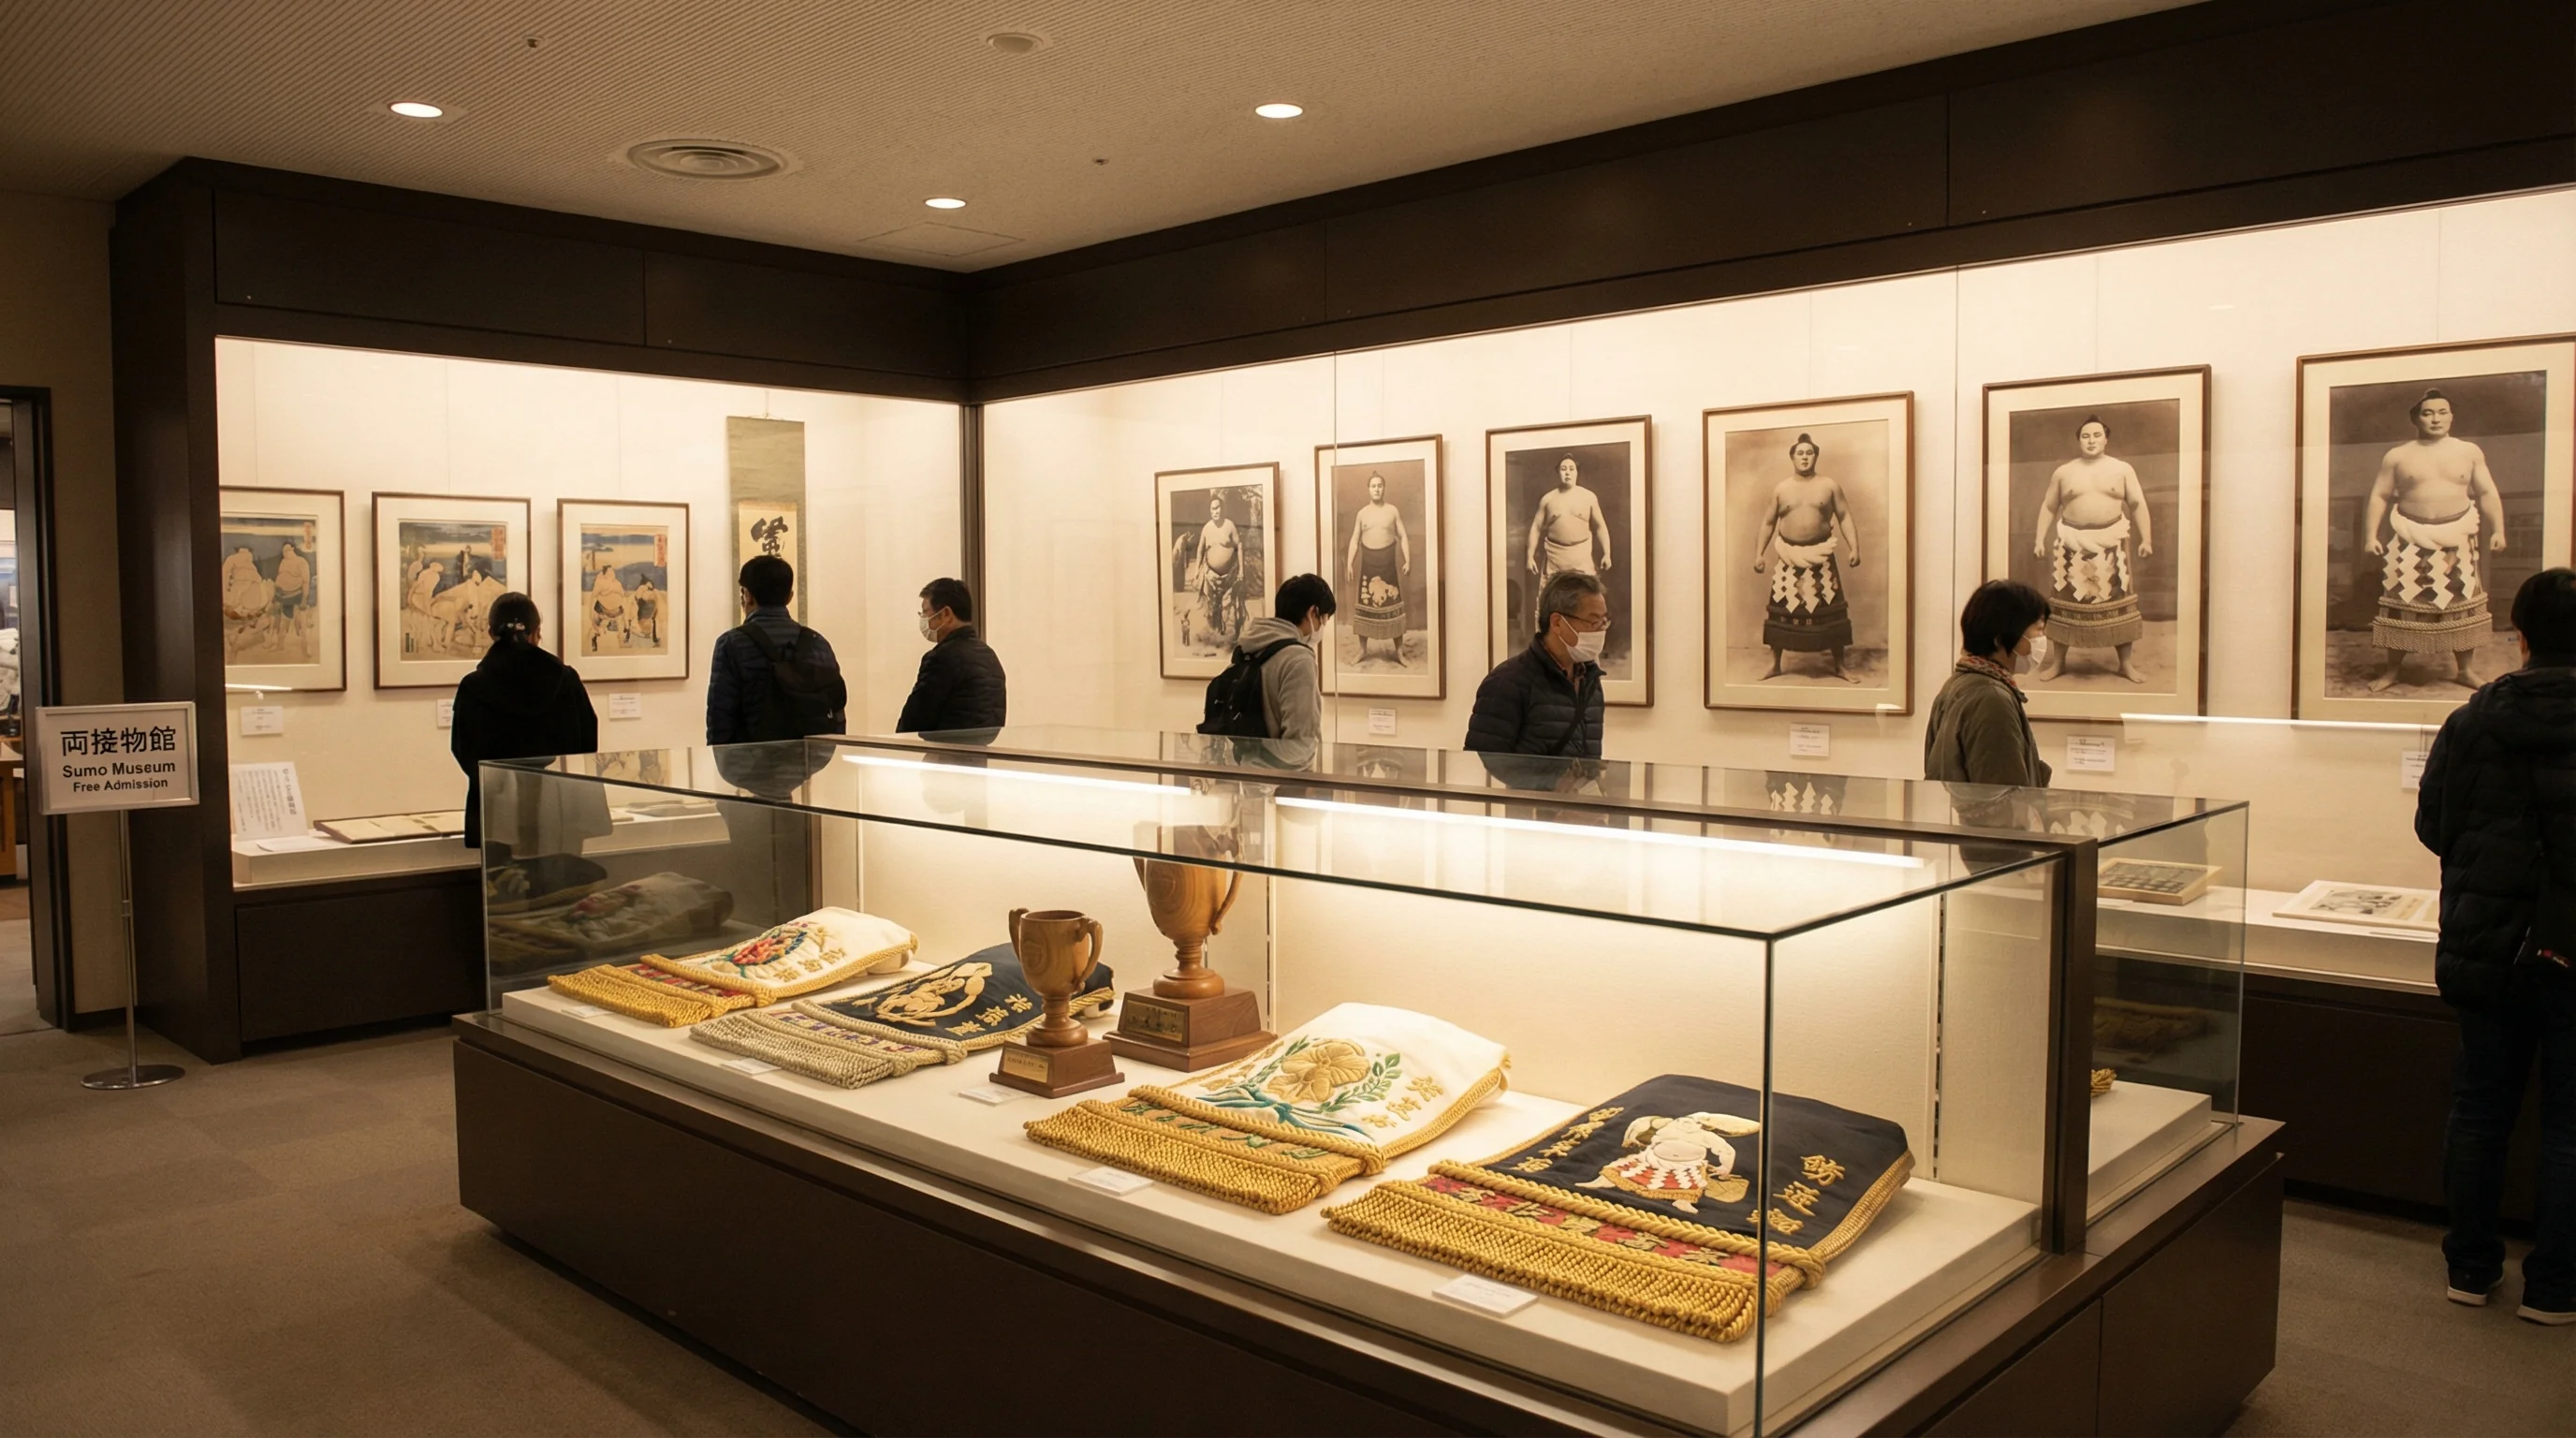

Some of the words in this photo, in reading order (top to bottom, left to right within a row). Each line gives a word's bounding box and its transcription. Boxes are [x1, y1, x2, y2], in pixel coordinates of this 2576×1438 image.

[63, 764, 108, 778] Sumo
[112, 762, 176, 775] Museum
[73, 781, 100, 792] Free
[104, 778, 168, 791] Admission
